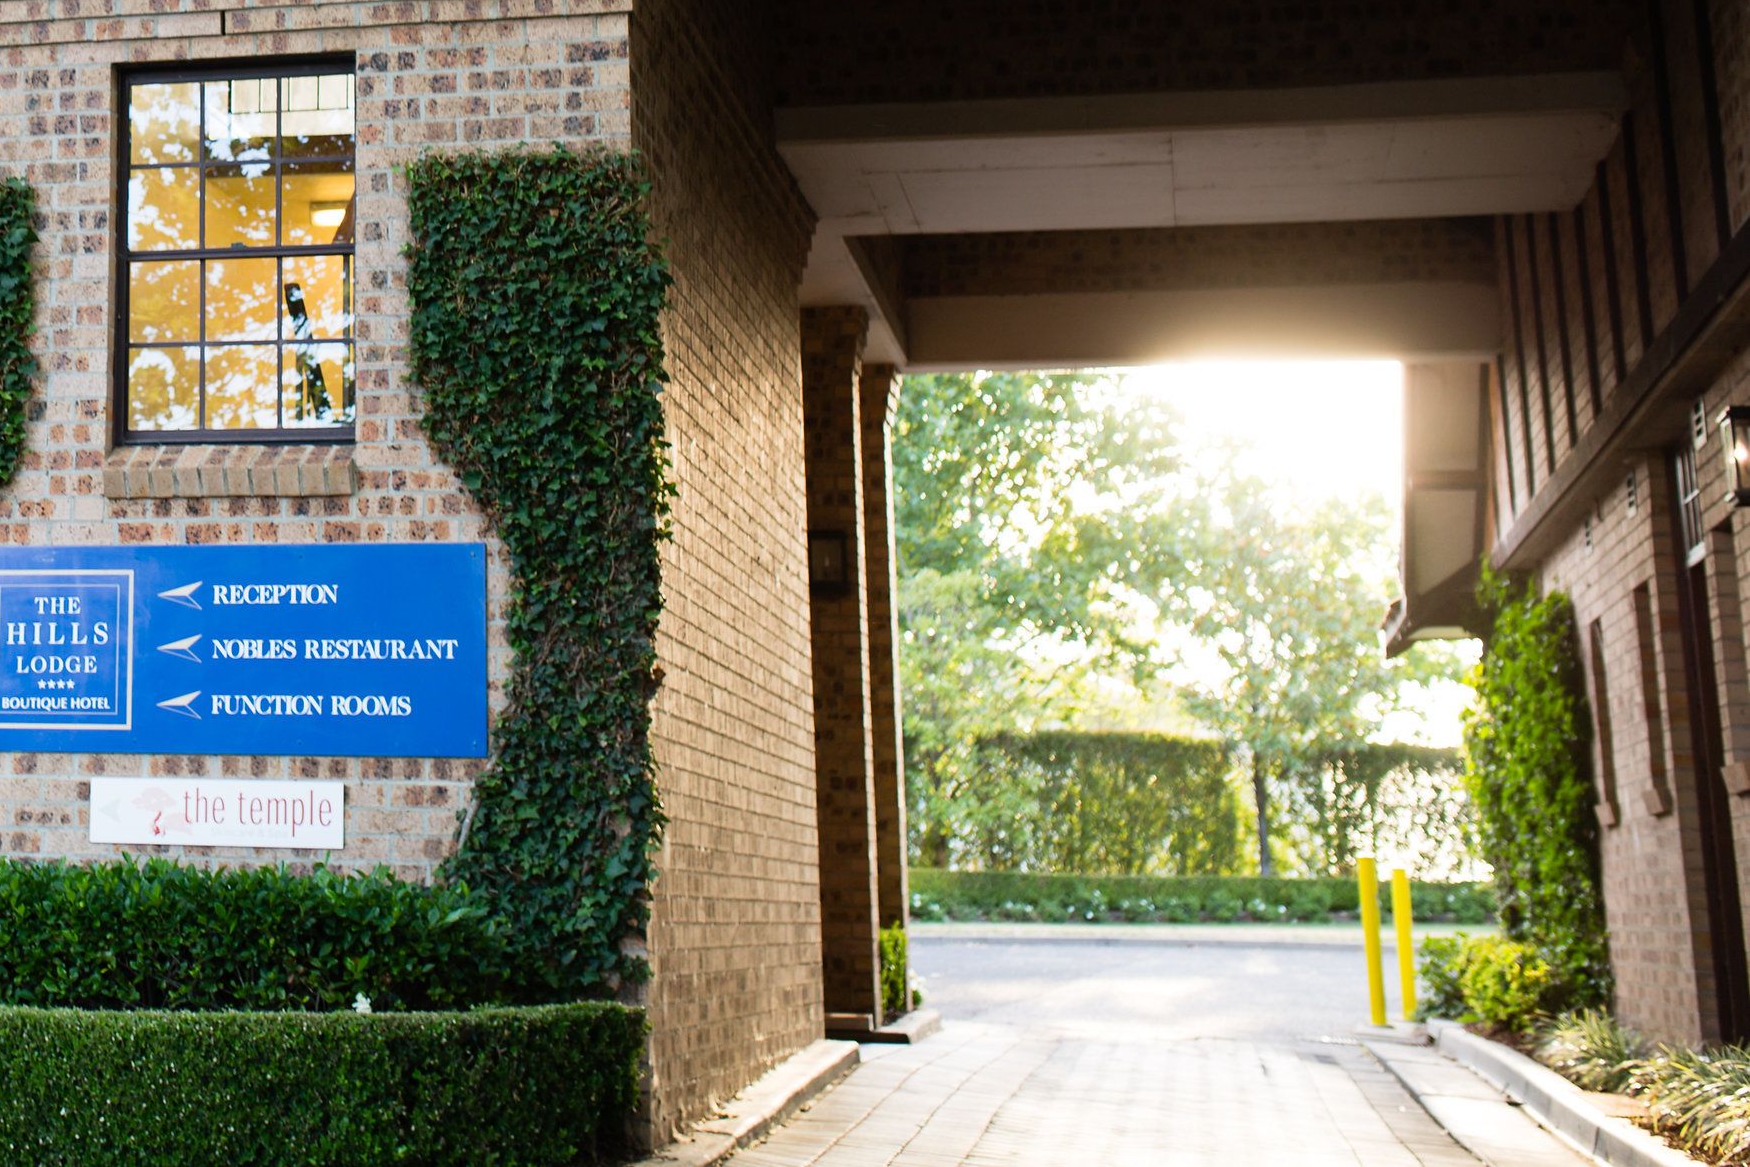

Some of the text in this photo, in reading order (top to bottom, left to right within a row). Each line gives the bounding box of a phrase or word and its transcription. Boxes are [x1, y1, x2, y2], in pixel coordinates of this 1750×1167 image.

[212, 584, 338, 605] RECEPTION
[34, 596, 81, 614] THE
[6, 622, 109, 645] HILLS
[211, 639, 459, 659] NOBLES RESTAURANT
[16, 655, 98, 673] LODGE
[2, 697, 110, 711] BOUTIQUE HOTEL
[211, 694, 412, 716] FUNCTION ROOMS
[183, 787, 332, 838] the temple
